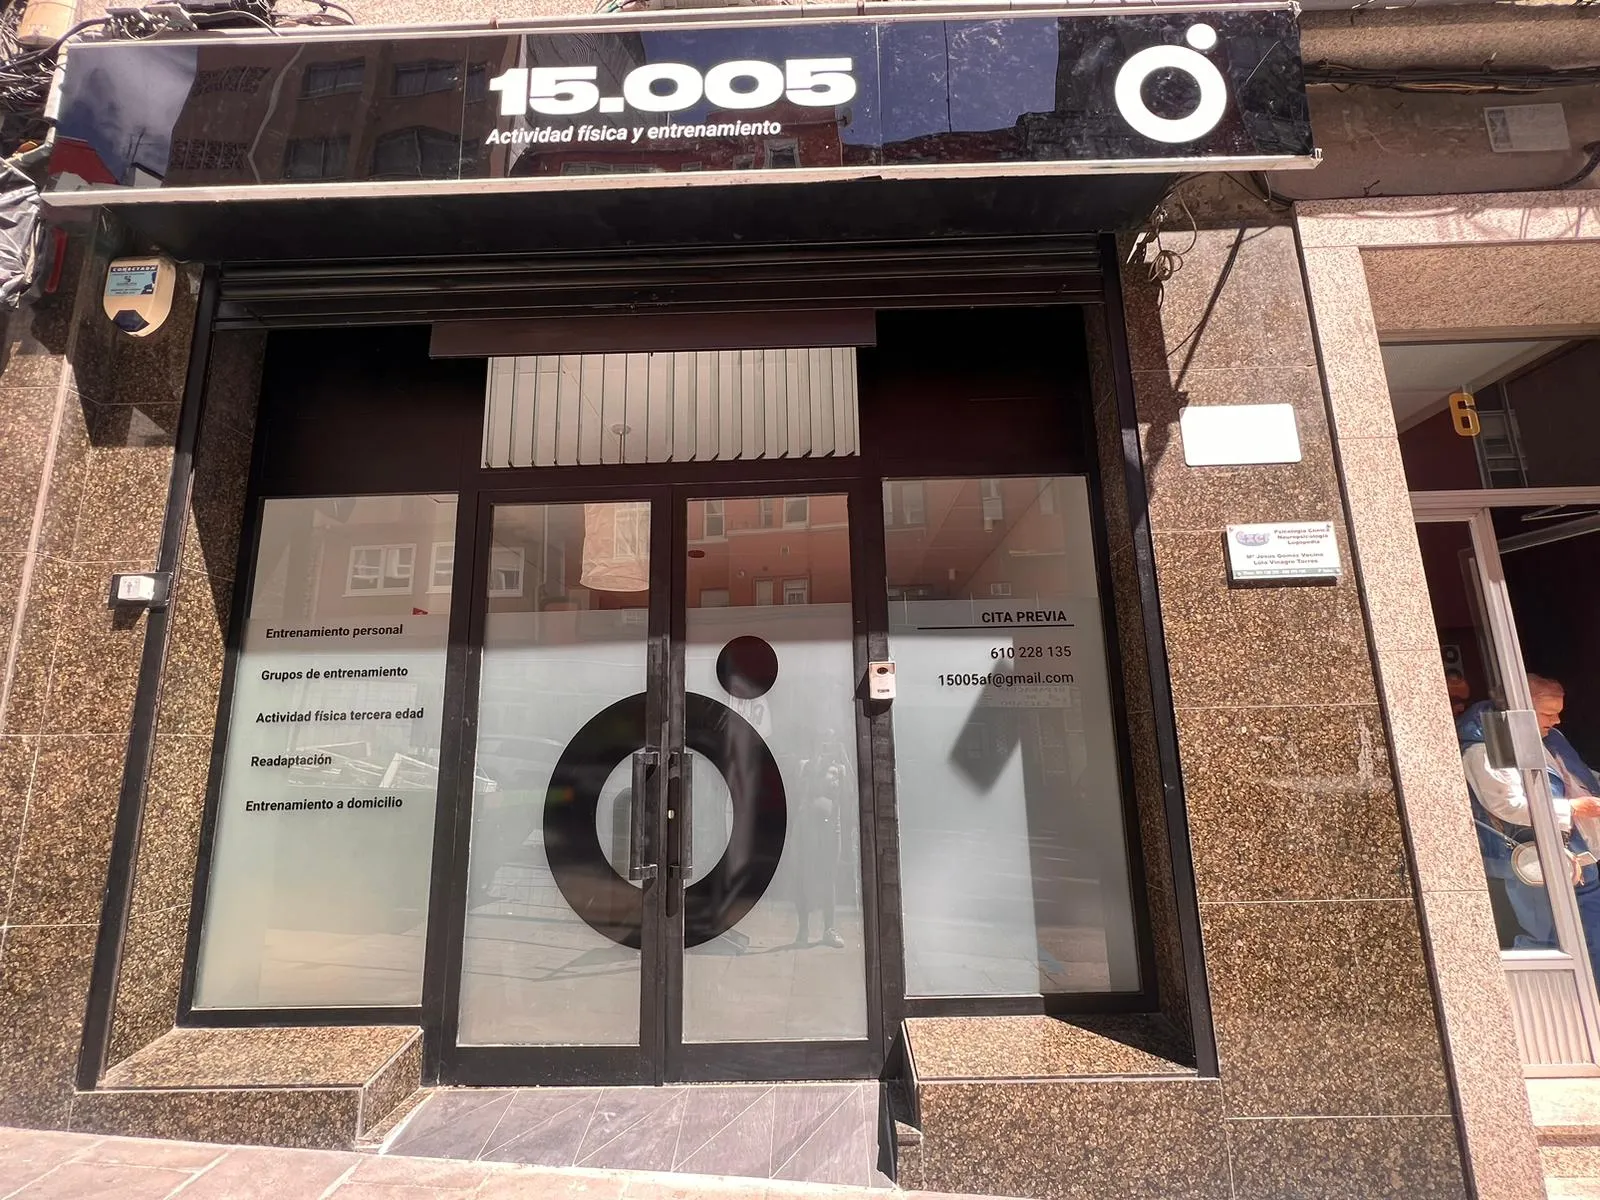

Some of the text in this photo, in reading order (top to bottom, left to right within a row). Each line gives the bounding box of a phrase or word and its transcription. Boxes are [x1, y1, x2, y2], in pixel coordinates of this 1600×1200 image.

[489, 57, 857, 116] 15.005
[485, 120, 782, 146] Actividad física y entrenamiento
[1449, 392, 1480, 436] 6
[982, 609, 1068, 623] CITA PREVIA
[266, 623, 404, 639] Entrenamiento personal
[991, 645, 1073, 659] 610 228 135
[261, 666, 409, 682] Grupos de entrenamiento
[937, 672, 1075, 688] 15005af@gmail.com
[256, 707, 425, 724] Actividad física tercera edad
[251, 753, 333, 768] Readaptación
[245, 796, 404, 811] Entrenamiento a domicilio
